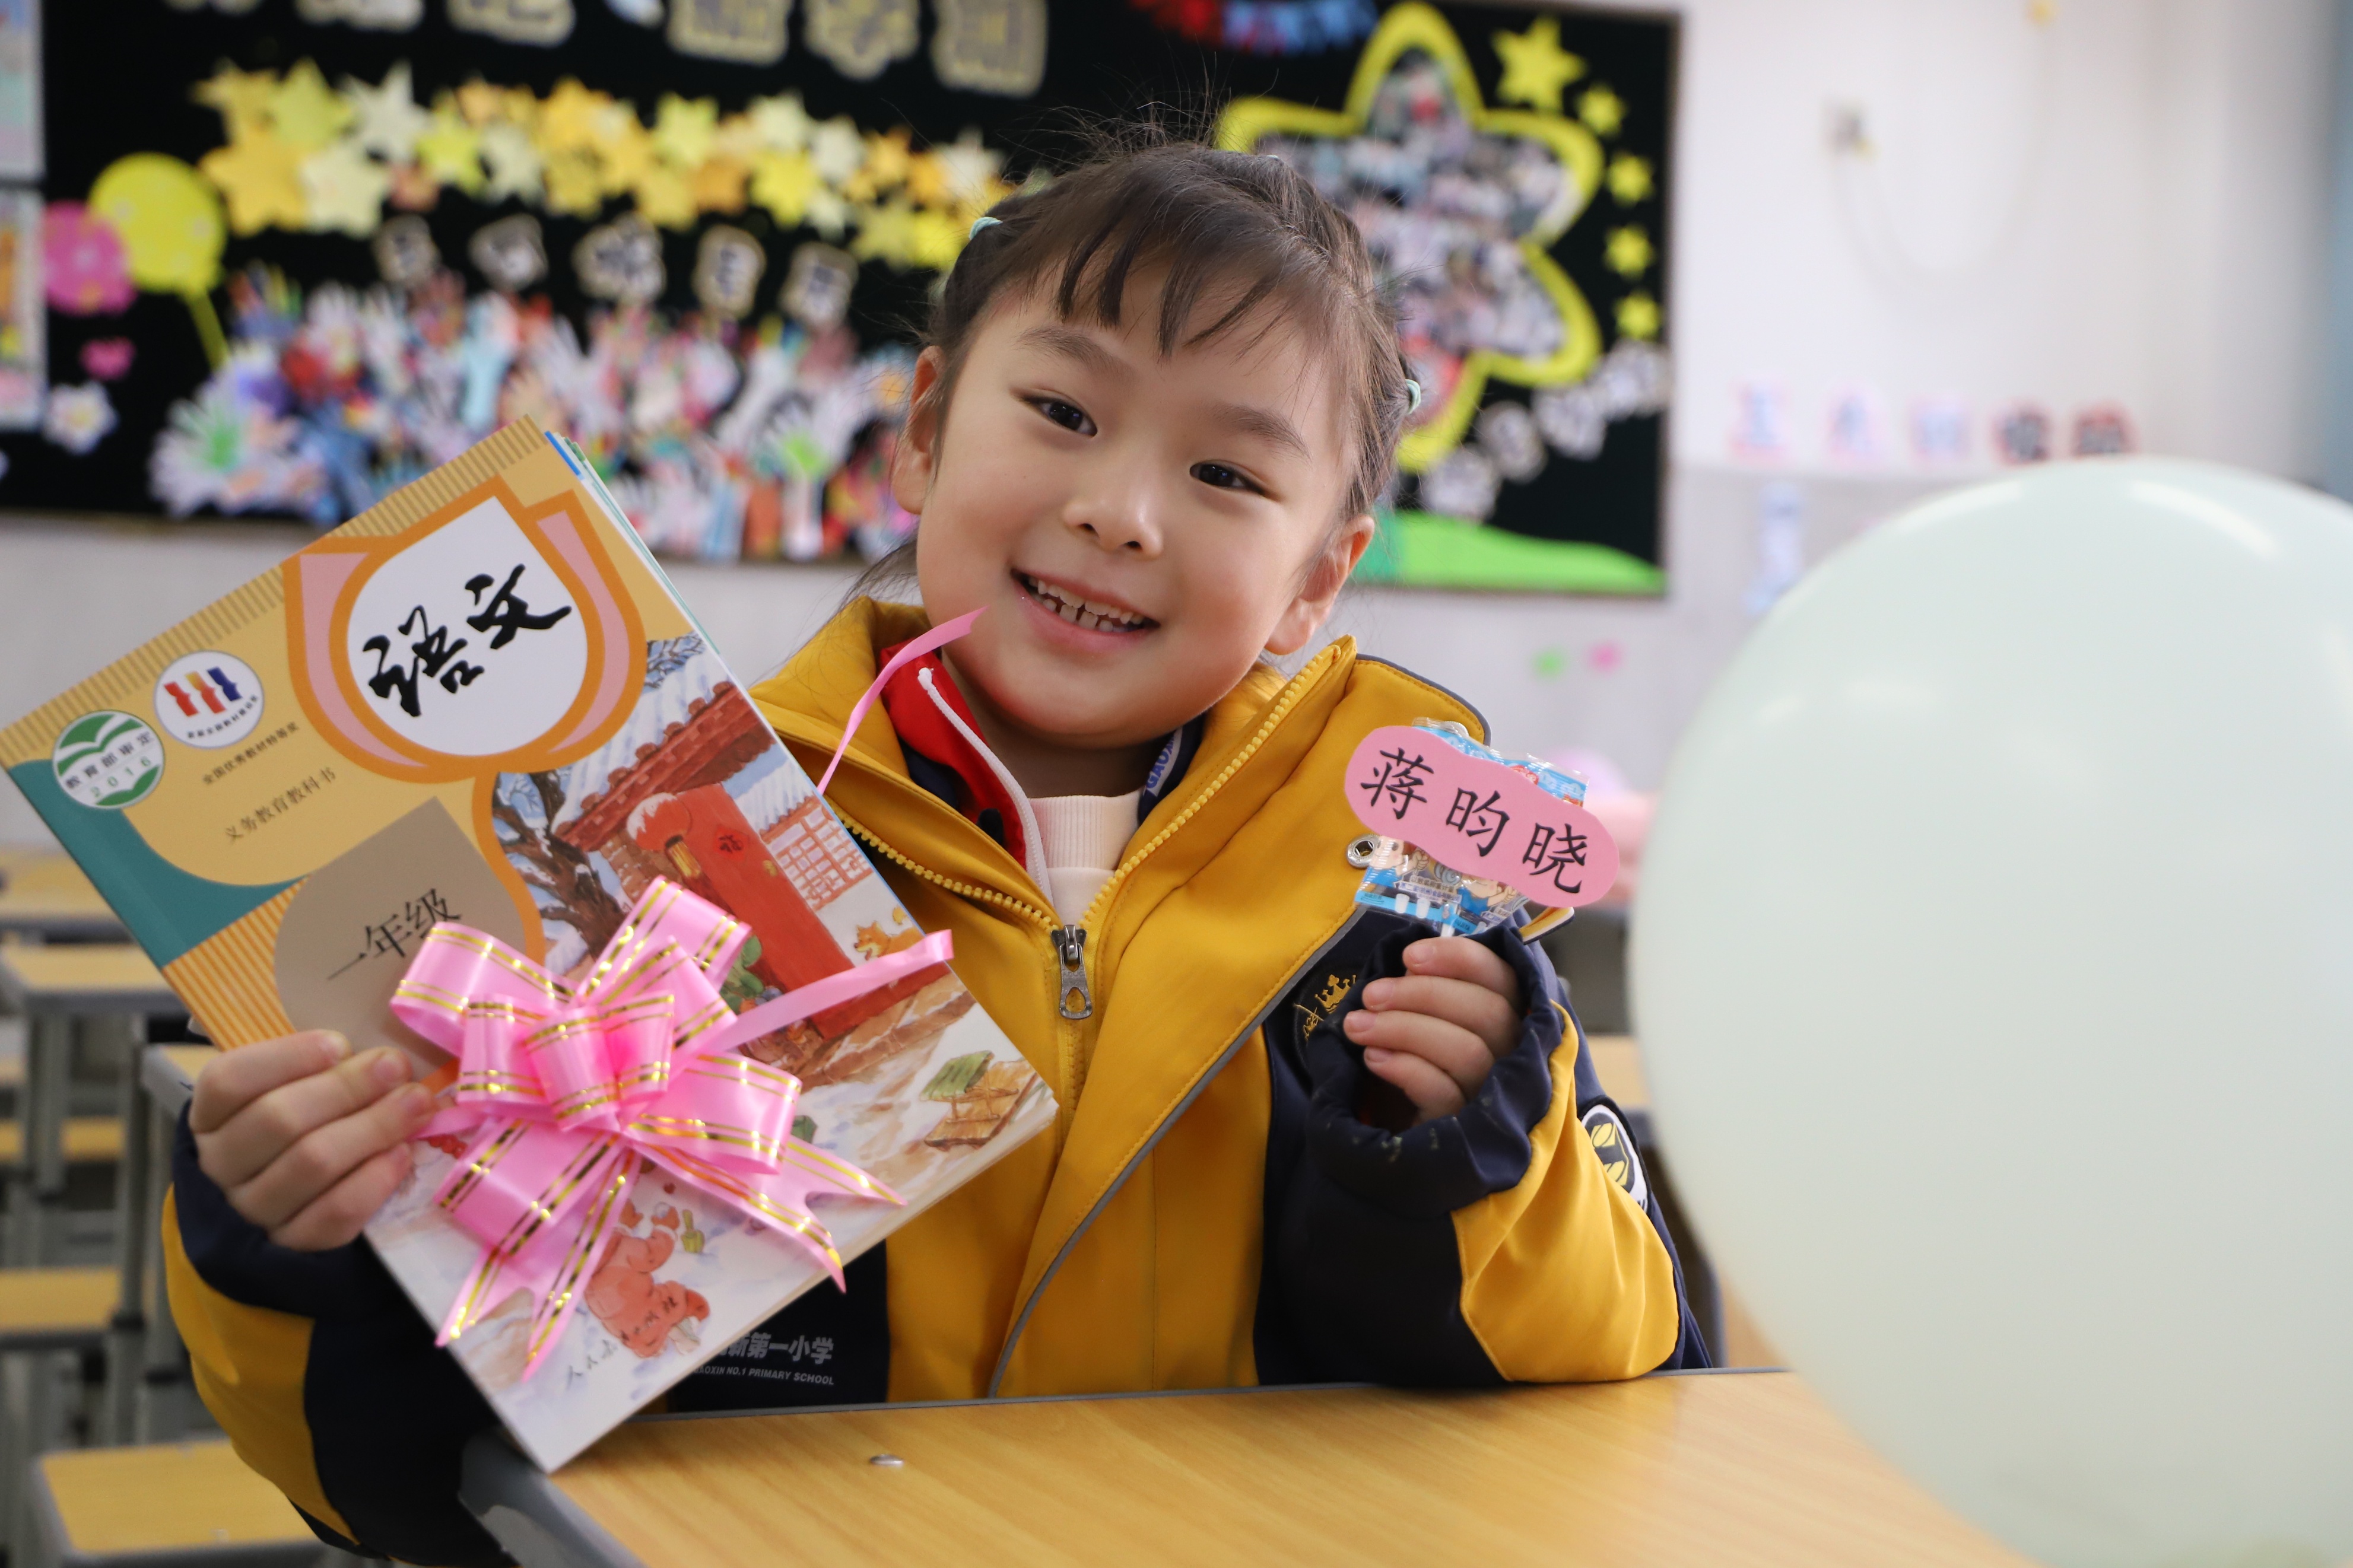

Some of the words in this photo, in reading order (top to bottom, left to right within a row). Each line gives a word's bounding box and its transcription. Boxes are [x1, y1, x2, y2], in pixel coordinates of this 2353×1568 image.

[363, 563, 572, 717] 语文
[65, 731, 151, 790] 教育部审定
[90, 756, 151, 799] 2016
[225, 766, 336, 842] 义务教育教科书
[1360, 747, 1588, 893] 蒋昀晓
[328, 888, 462, 981] 一年级
[718, 1332, 834, 1365] 新第一小学
[726, 1366, 746, 1376] NO.1
[748, 1368, 792, 1380] PRIMARY
[793, 1372, 834, 1385] SCHOOL
